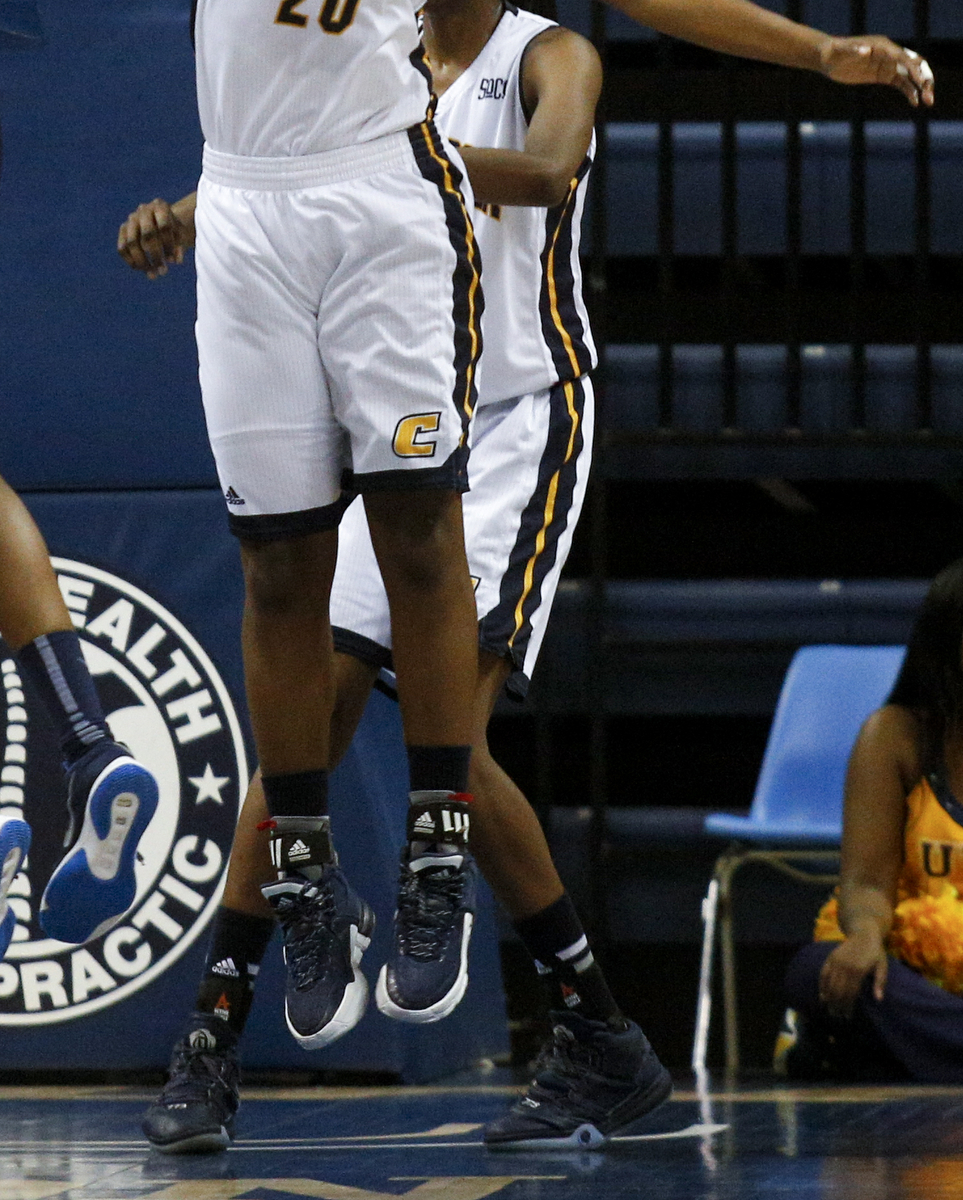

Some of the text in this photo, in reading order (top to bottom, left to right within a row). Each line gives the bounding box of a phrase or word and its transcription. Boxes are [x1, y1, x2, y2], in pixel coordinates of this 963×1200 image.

[392, 411, 442, 459] C
[56, 575, 223, 745] EALTH
[922, 841, 953, 878] U
